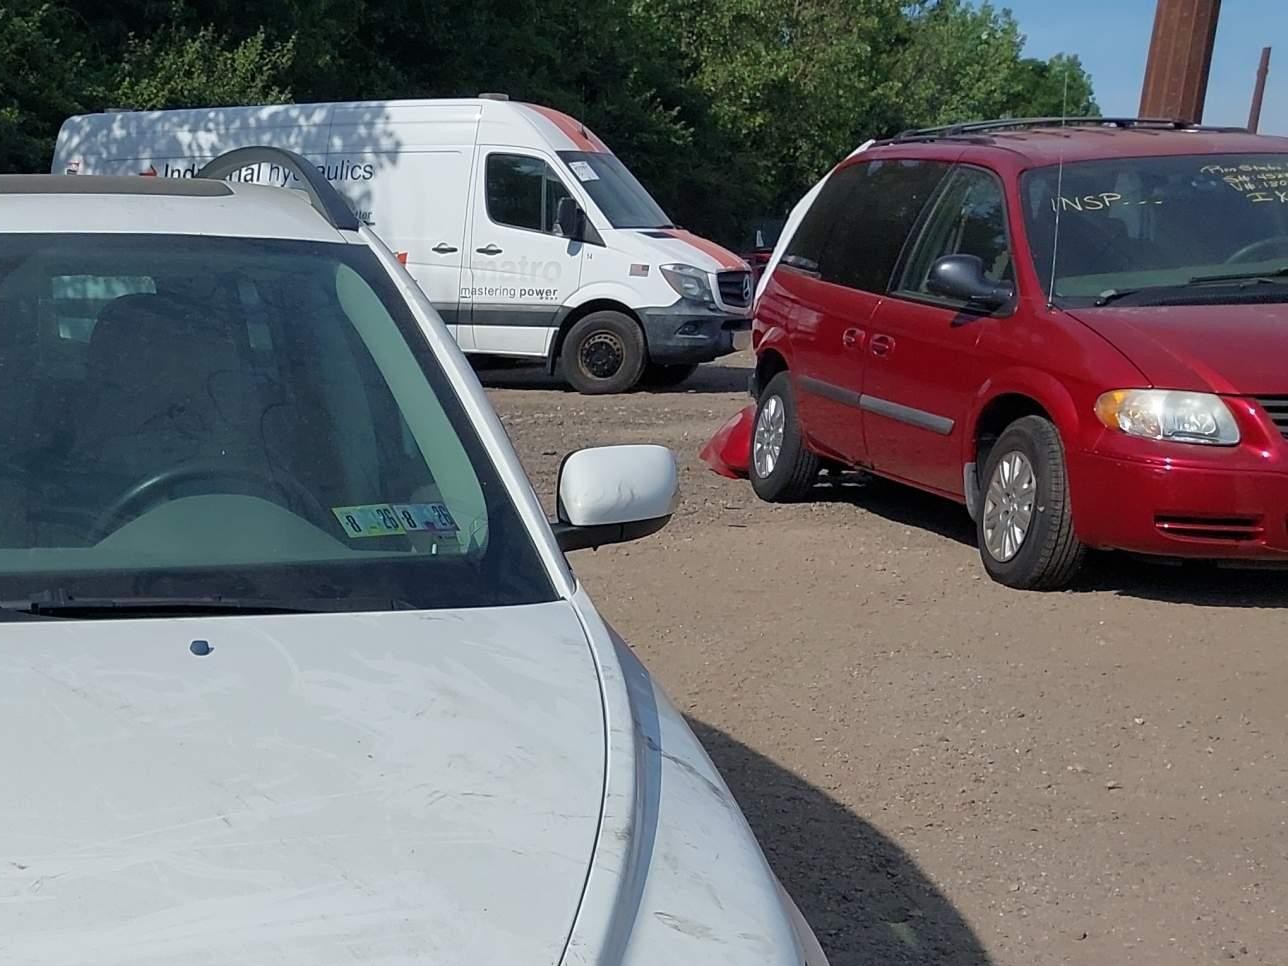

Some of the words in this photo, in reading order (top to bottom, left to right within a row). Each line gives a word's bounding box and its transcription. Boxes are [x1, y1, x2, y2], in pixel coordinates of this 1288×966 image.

[460, 285, 516, 299] mastering
[519, 288, 558, 299] power
[375, 508, 399, 529] 26
